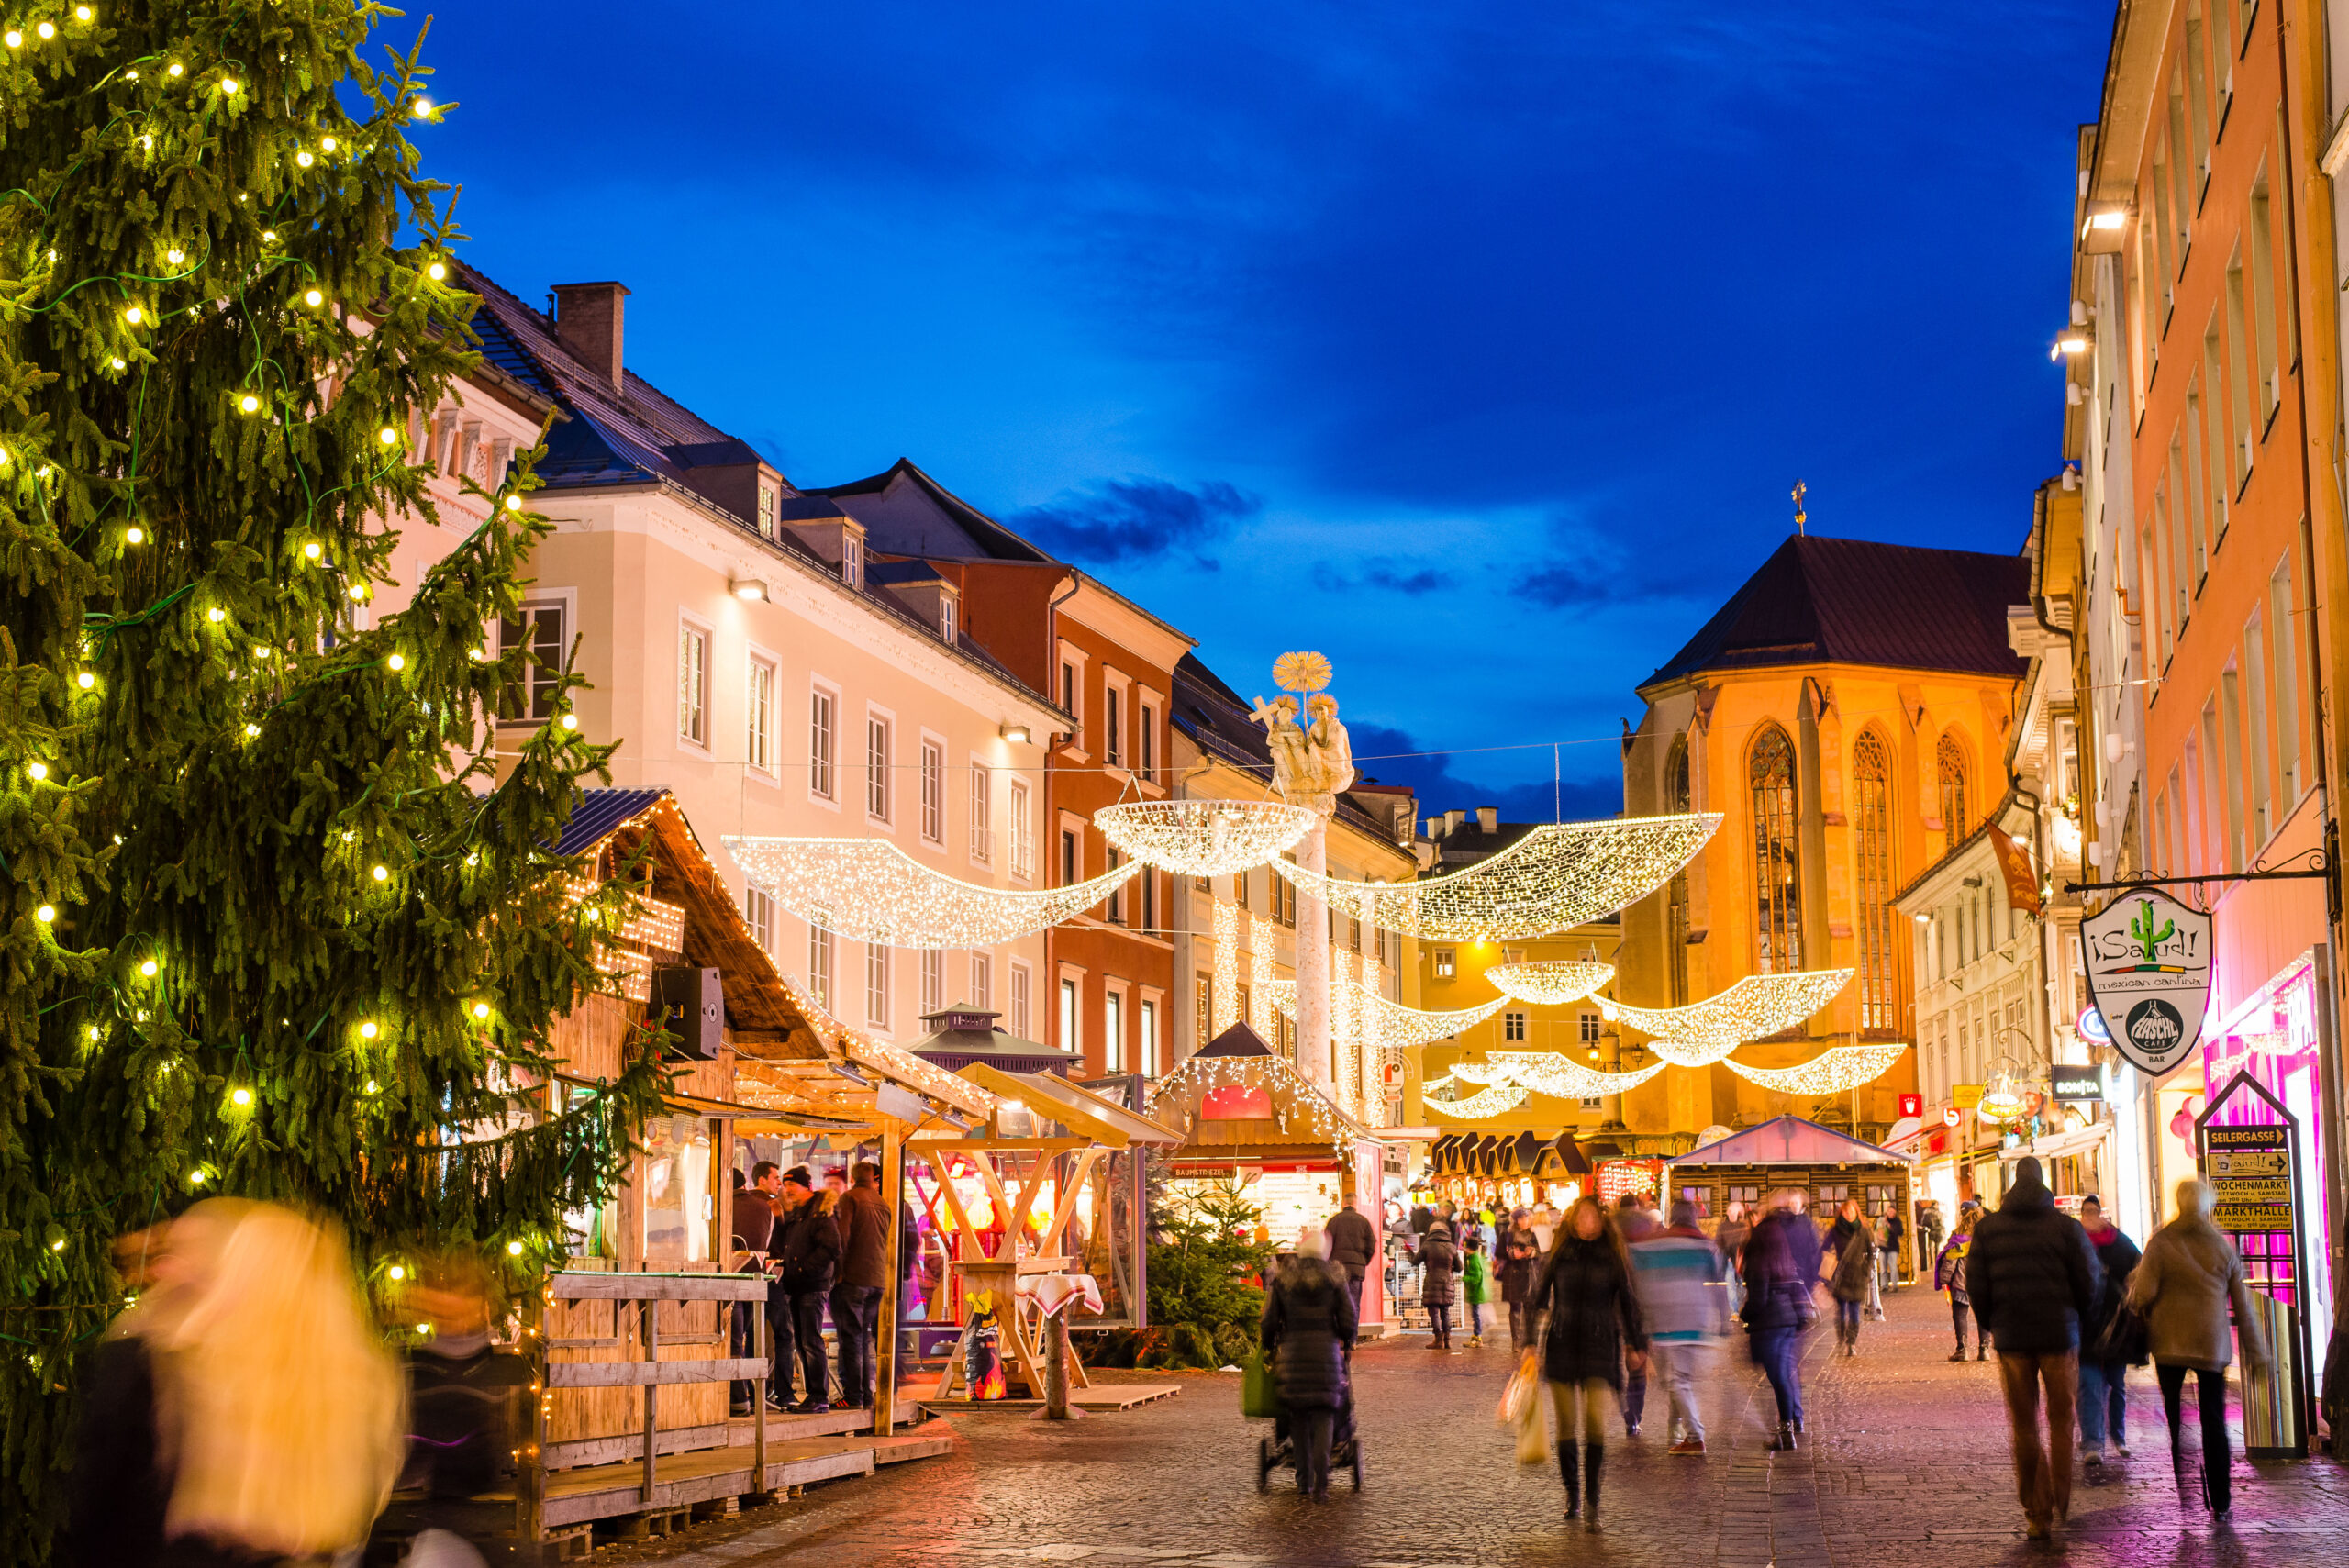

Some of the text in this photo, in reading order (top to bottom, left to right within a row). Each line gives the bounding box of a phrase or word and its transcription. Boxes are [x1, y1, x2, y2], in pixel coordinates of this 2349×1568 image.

[2098, 974, 2200, 989] mexican cantina
[2056, 1079, 2099, 1095] BONITA
[2211, 1131, 2275, 1143] SEILERGASSE
[2211, 1181, 2288, 1190] WOCHENMARKT
[2213, 1207, 2290, 1217] MARKTHALLE
